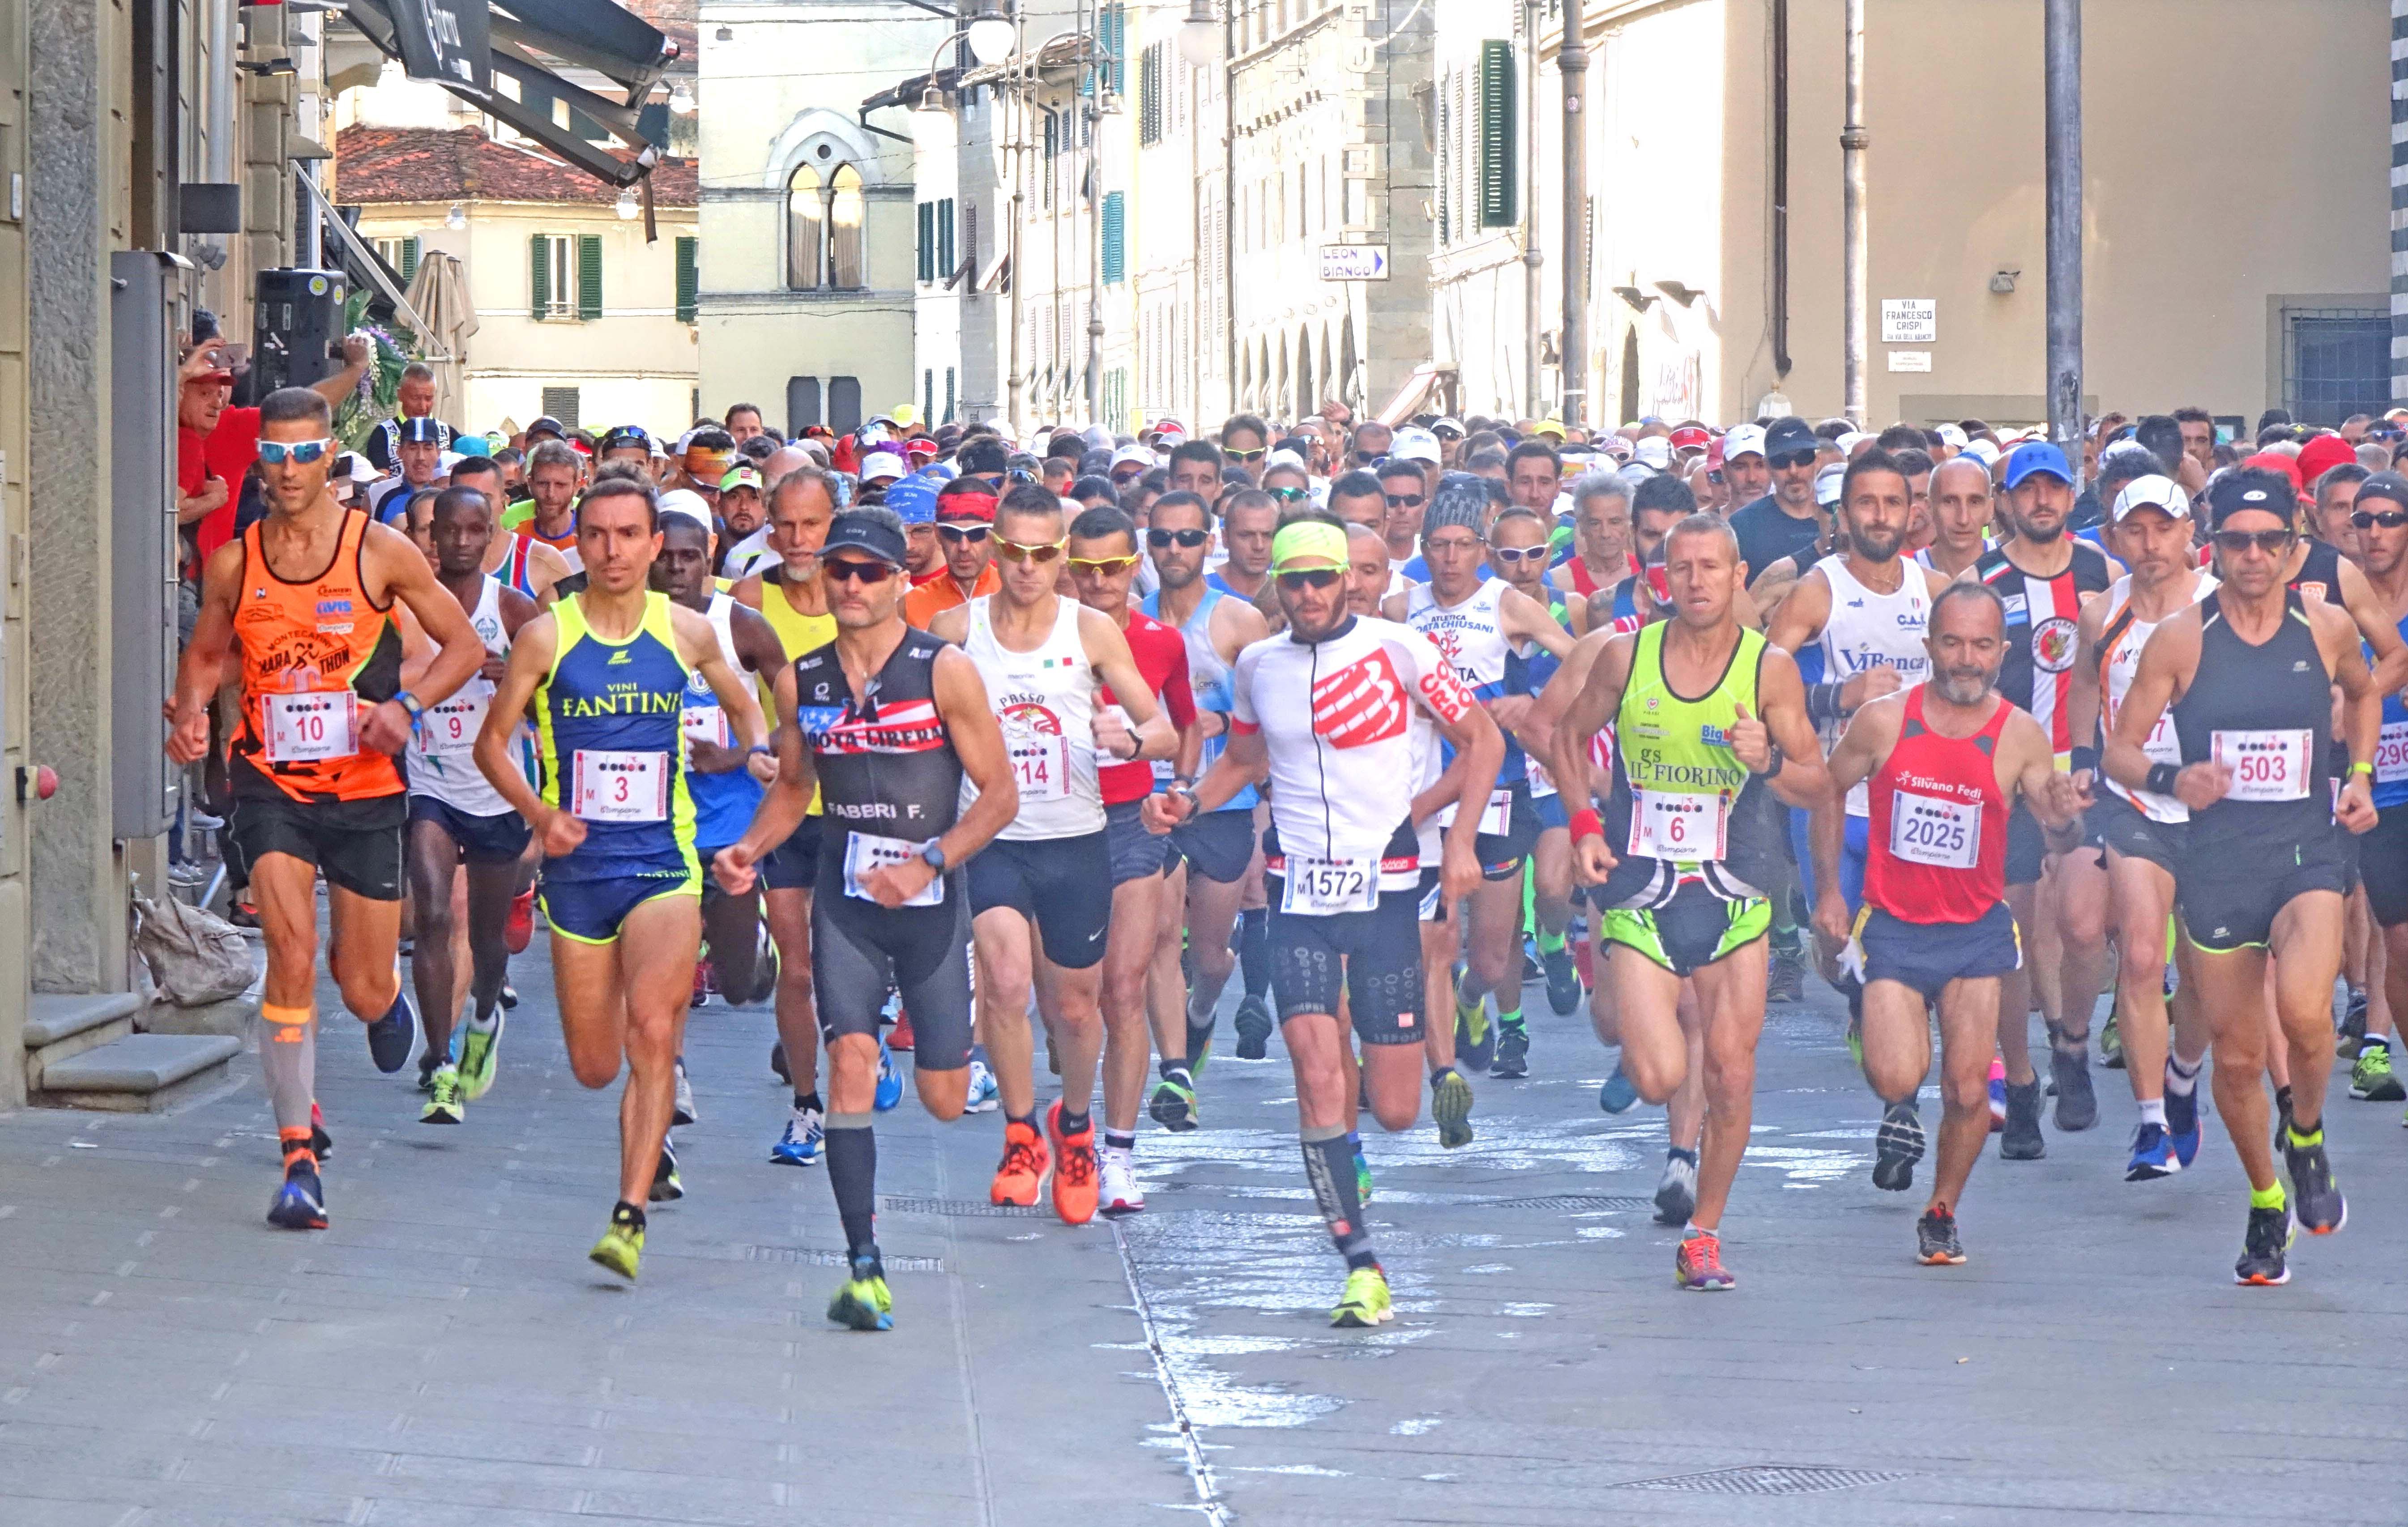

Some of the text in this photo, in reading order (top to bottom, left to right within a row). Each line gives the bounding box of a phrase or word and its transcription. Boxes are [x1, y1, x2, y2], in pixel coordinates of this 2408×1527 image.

[1324, 249, 1358, 259] LEON
[1324, 266, 1370, 277] BIANCO
[1902, 300, 1916, 309] VIA
[1886, 311, 1932, 320] FRANCESCO
[1896, 321, 1921, 330] CRISPI
[1431, 614, 1466, 623] ATLETICA
[1441, 621, 1494, 634] CHIUSANI
[319, 648, 350, 675] THON
[606, 682, 638, 692] VINI
[562, 691, 680, 717] FANTINI
[999, 693, 1045, 707] PASSO
[295, 716, 324, 742] 10
[448, 717, 462, 739] 9
[277, 731, 285, 742] M
[1641, 748, 1661, 769] gs
[1631, 762, 1741, 786] IL FIORINO
[2240, 756, 2286, 781] 503
[586, 789, 594, 800] M
[615, 776, 628, 802] 3
[1911, 776, 1982, 799] Silvano Fedi
[828, 802, 925, 819] FABBRI F.
[1644, 827, 1652, 837] M
[1670, 816, 1684, 842] 6
[1903, 818, 1965, 850] 2025
[1298, 884, 1306, 895] M
[1306, 870, 1362, 896] 1572
